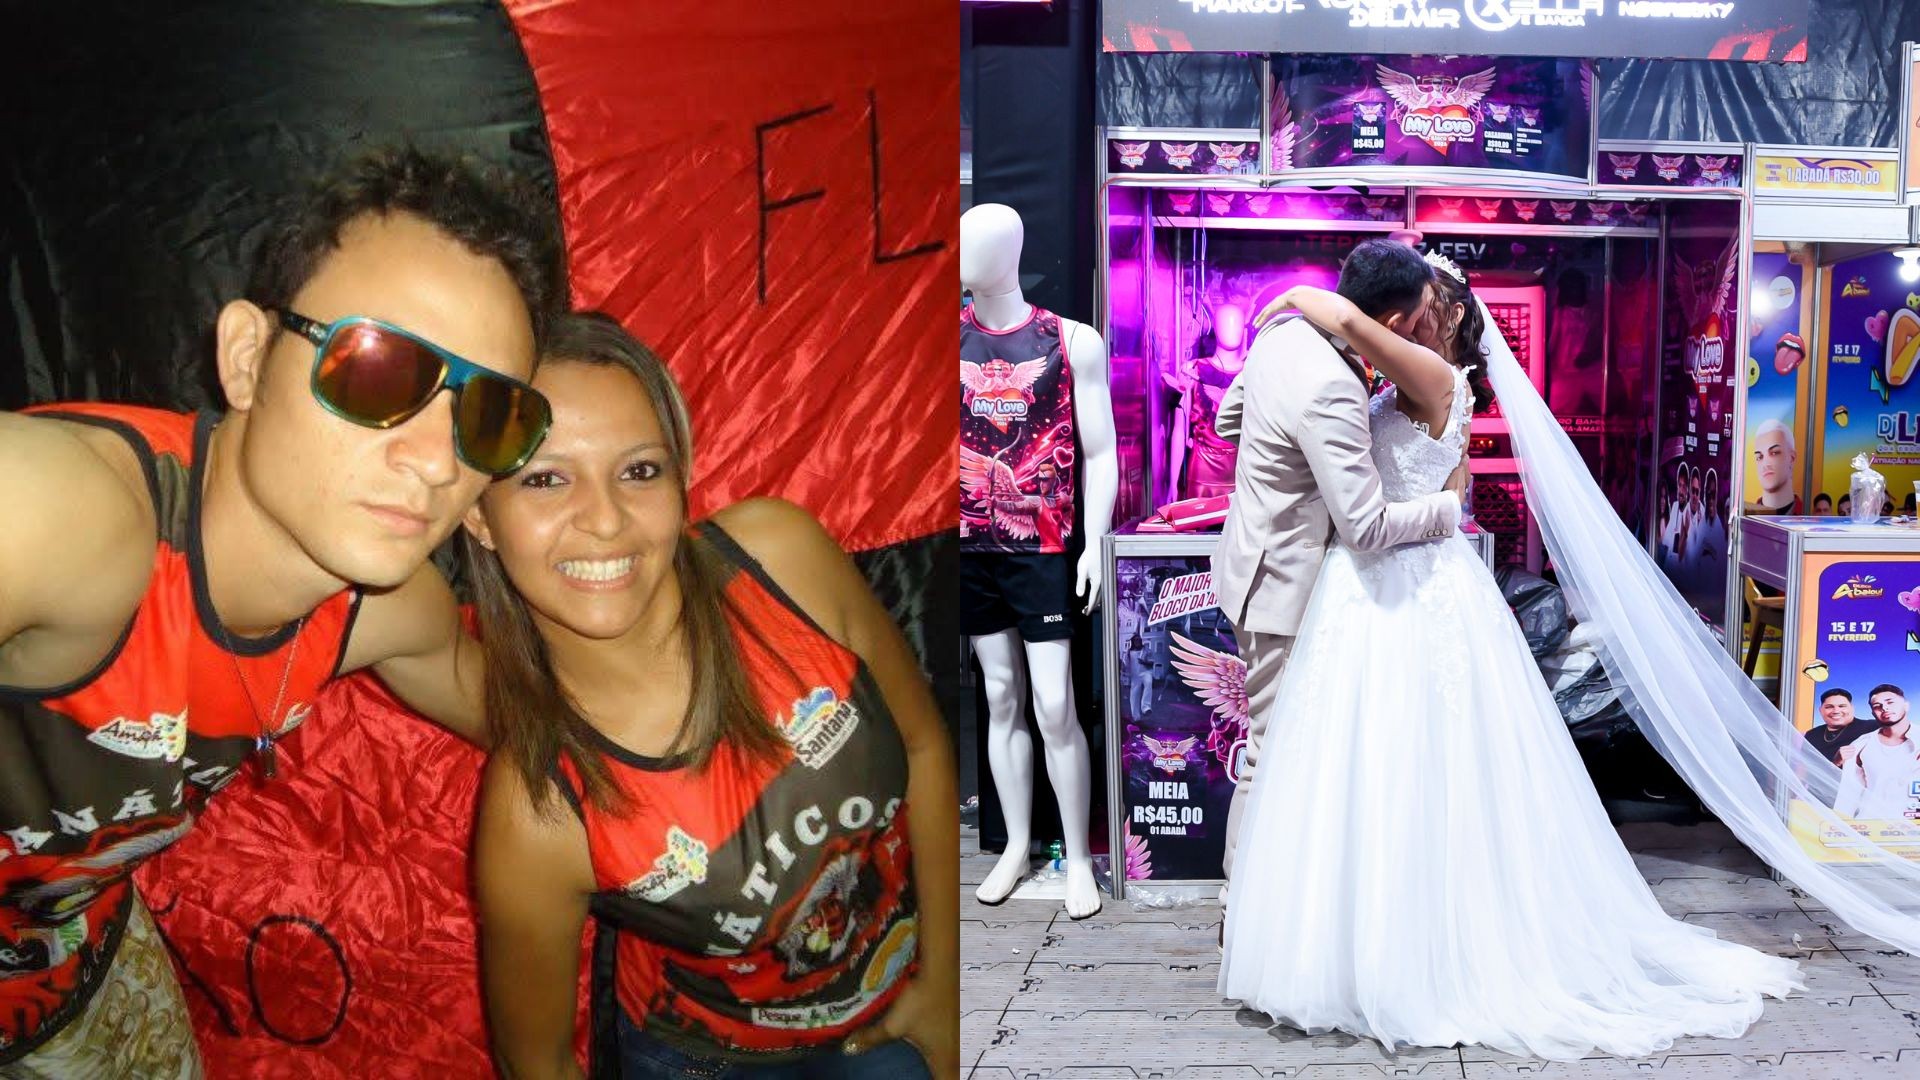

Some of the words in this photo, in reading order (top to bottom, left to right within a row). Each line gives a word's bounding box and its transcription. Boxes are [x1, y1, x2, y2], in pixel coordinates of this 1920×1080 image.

[1348, 8, 1461, 29] DELMIR
[1405, 117, 1432, 136] My
[1434, 116, 1472, 133] Love
[1701, 339, 1722, 367] Love
[1834, 344, 1843, 354] 15
[1851, 344, 1860, 356] 17
[973, 399, 994, 417] My
[996, 399, 1026, 414] Love
[1879, 415, 1897, 442] Dj
[1161, 579, 1173, 600] O
[1150, 596, 1190, 623] BLOCO
[1189, 593, 1206, 611] DA
[1043, 614, 1063, 623] BOSS
[1831, 621, 1846, 633] 15
[1849, 621, 1857, 633] E
[1860, 621, 1876, 634] 17
[1828, 633, 1877, 642] FEVEREIRO
[796, 702, 852, 764] Santana
[1148, 781, 1190, 800] MEIA
[1133, 804, 1204, 826] R$45,00
